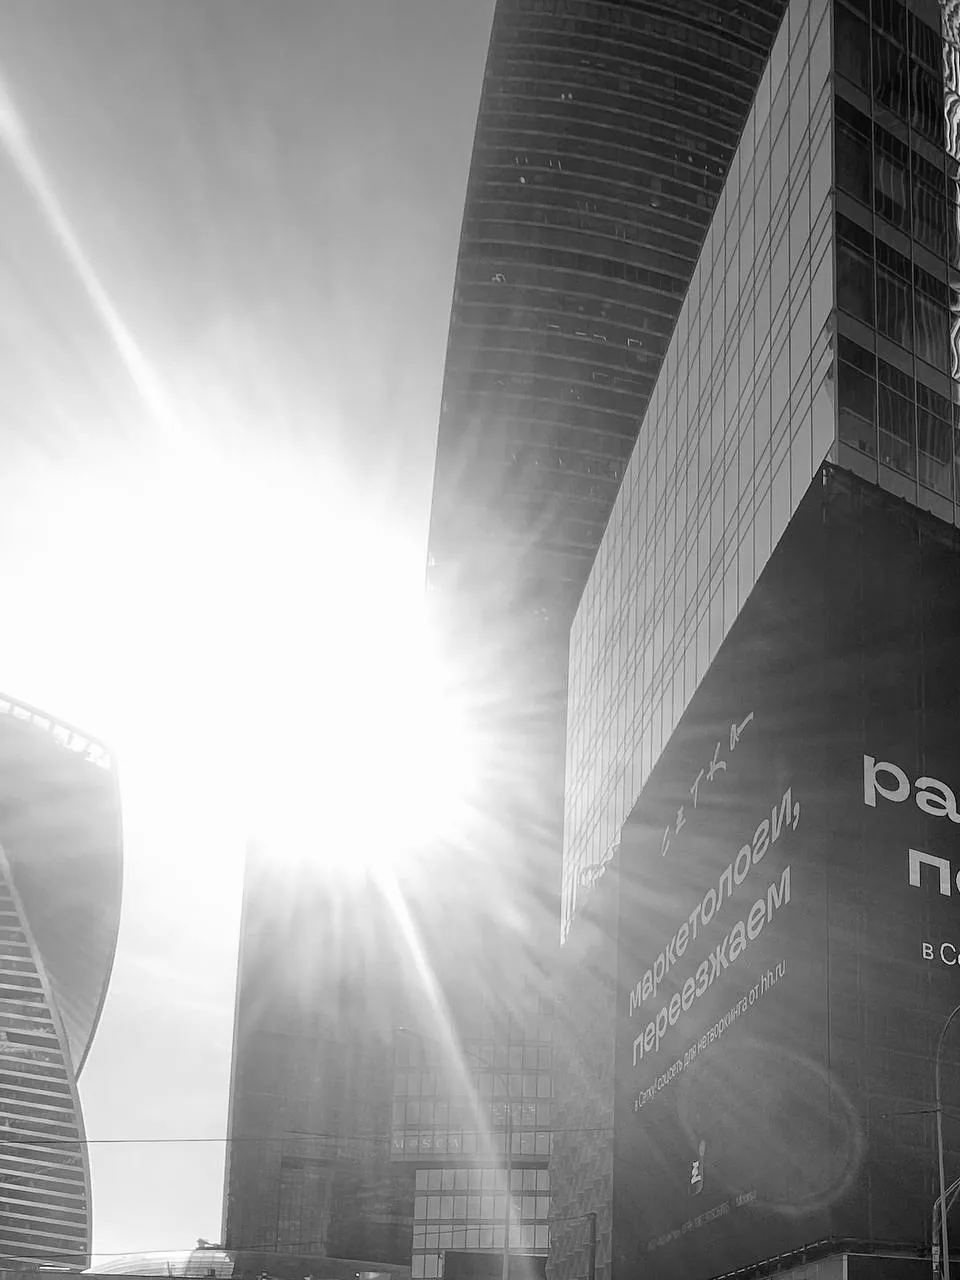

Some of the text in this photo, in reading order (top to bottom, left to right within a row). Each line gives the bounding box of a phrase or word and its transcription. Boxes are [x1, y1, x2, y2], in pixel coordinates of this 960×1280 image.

[629, 786, 801, 1018] маркетологи,
[922, 942, 934, 960] в
[632, 865, 792, 1067] переезжаем
[760, 959, 786, 996] hh.ru
